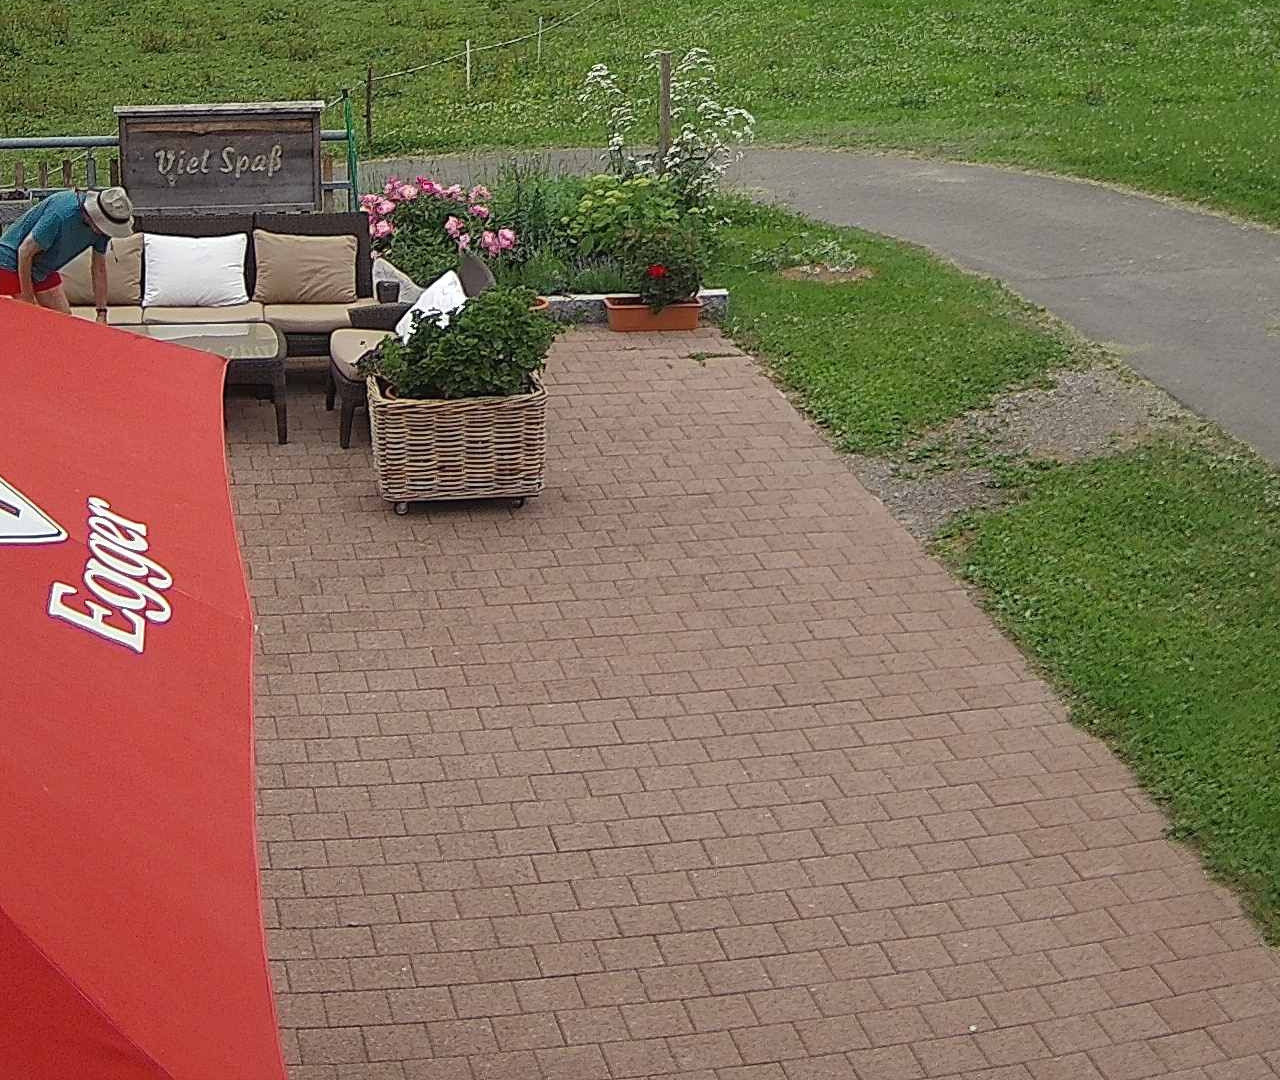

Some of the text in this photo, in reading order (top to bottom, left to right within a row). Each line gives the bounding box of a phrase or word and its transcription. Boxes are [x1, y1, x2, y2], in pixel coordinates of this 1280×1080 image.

[154, 143, 283, 179] Viel Spaß
[47, 496, 173, 654] Egger
